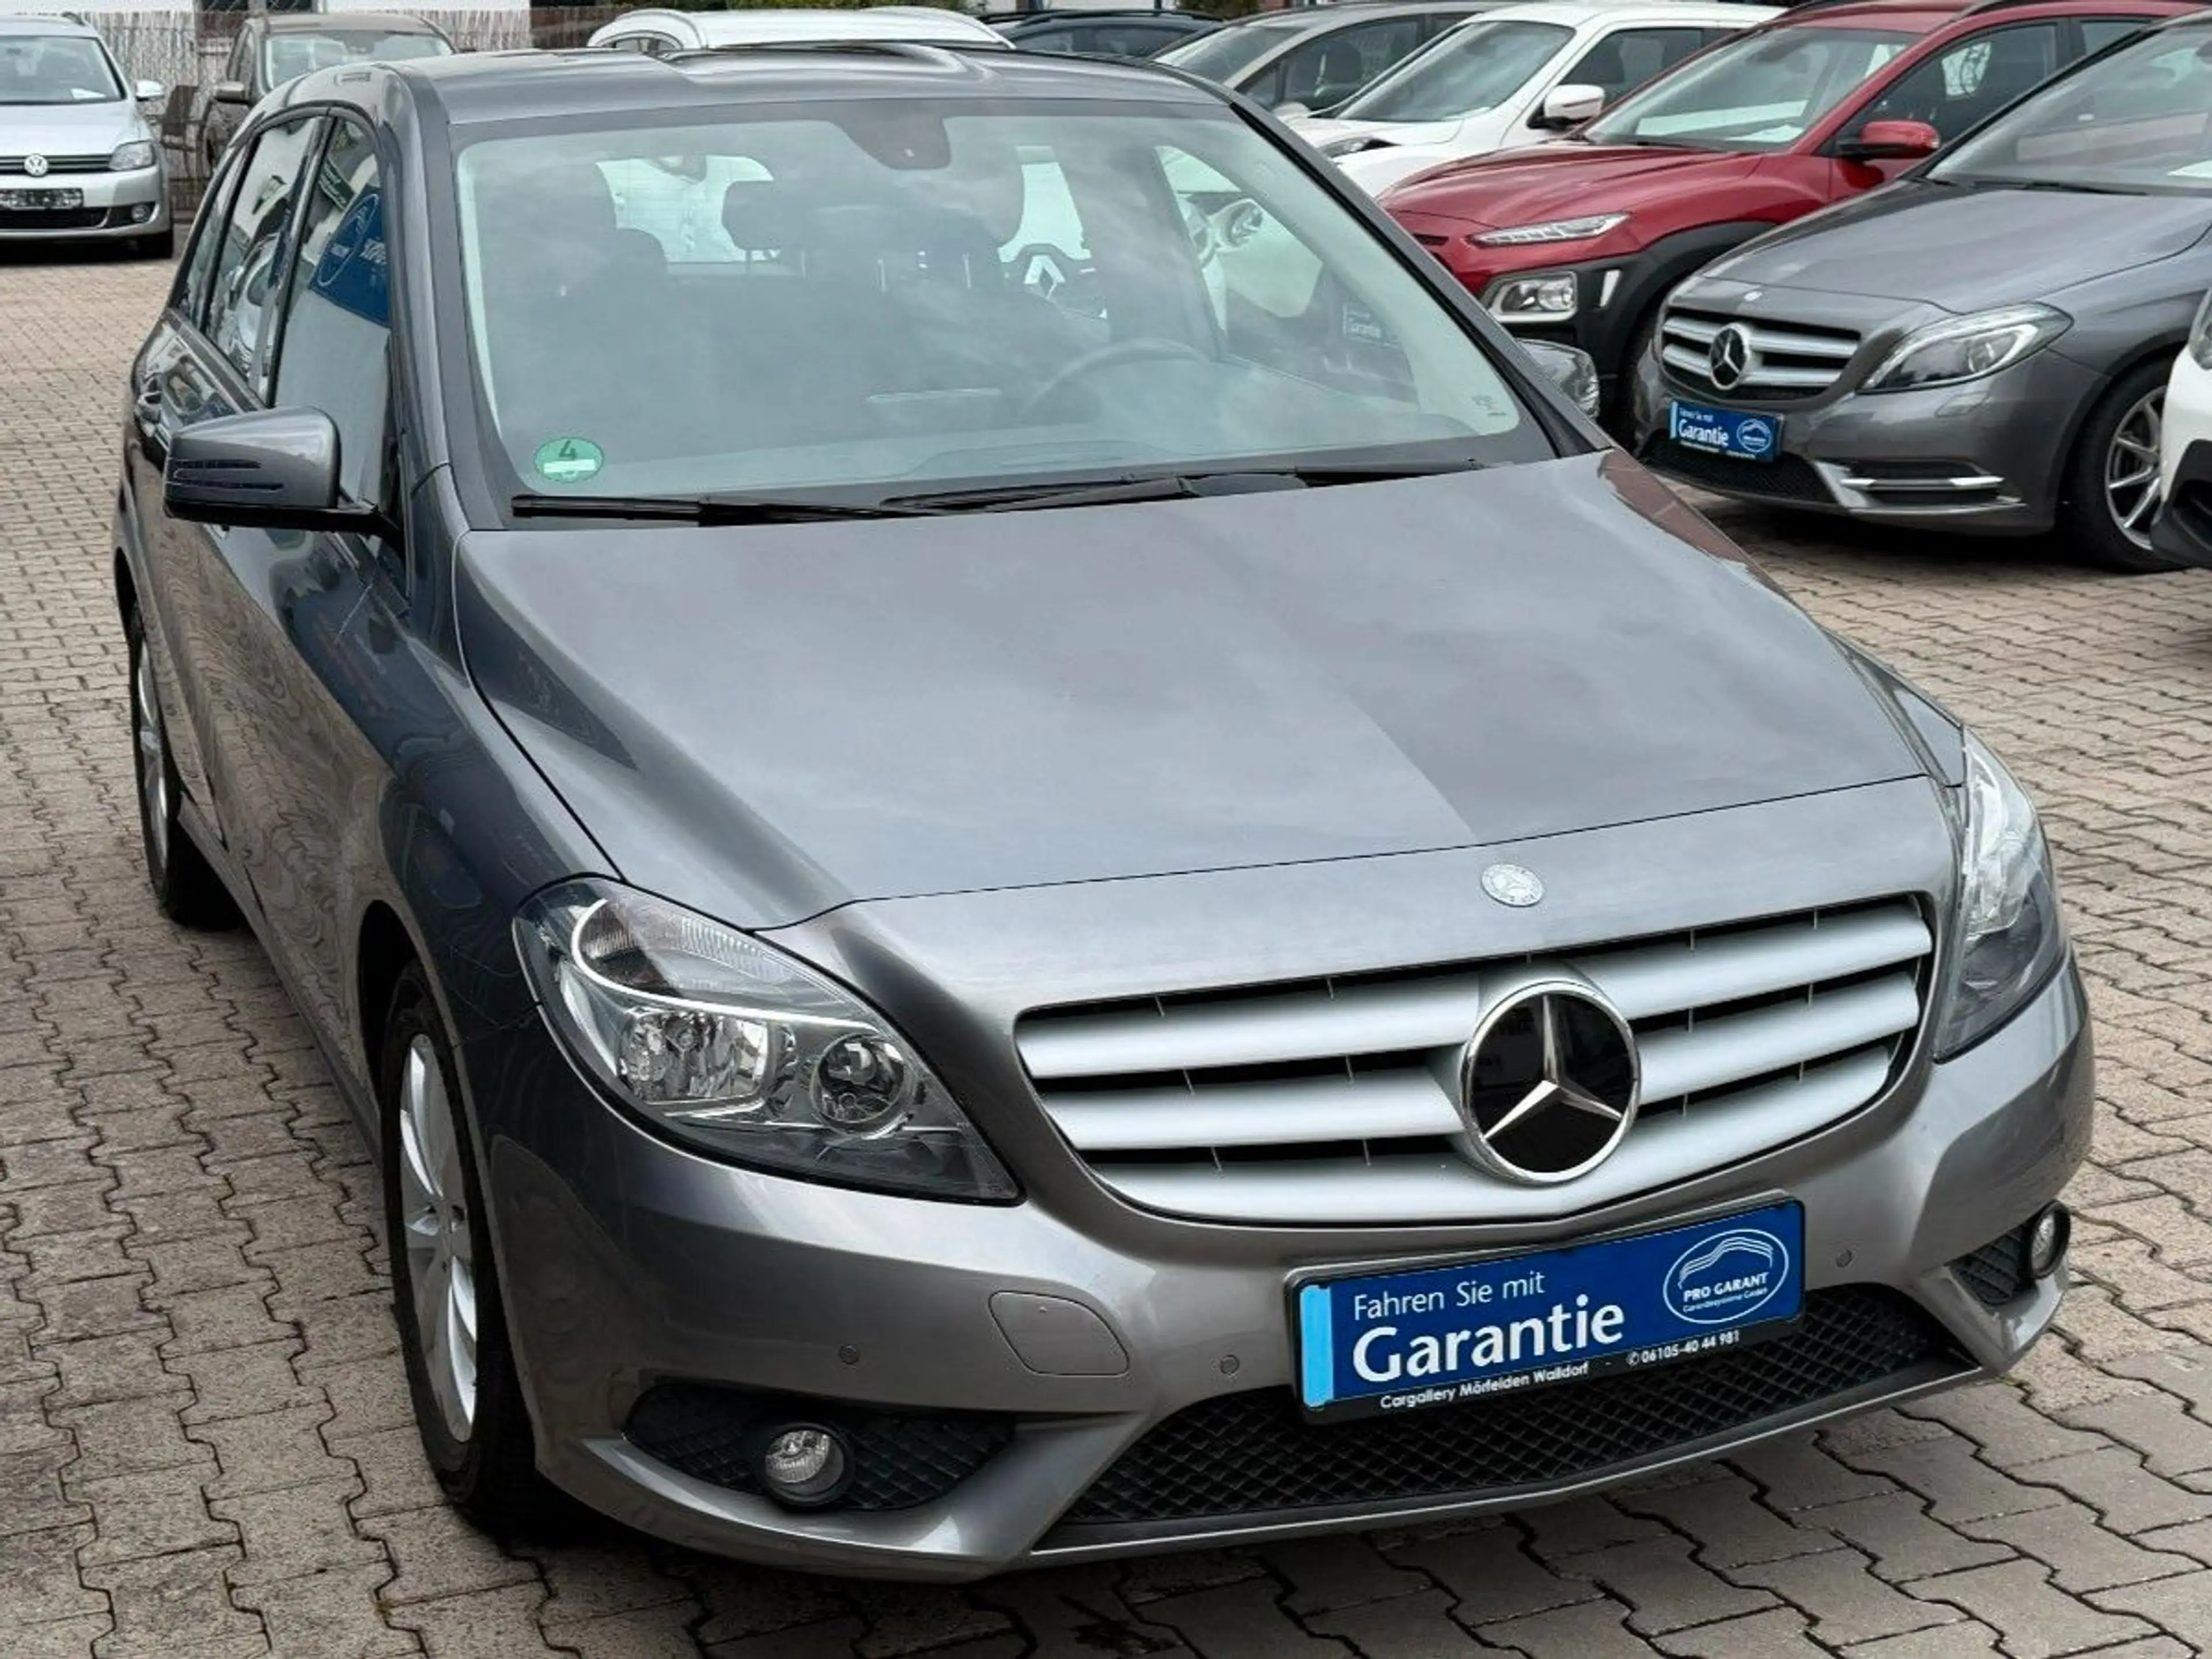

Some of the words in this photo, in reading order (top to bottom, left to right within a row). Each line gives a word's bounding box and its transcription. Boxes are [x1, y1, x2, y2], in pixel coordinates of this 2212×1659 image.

[559, 440, 578, 459] 4
[1679, 418, 1729, 448] Garantie
[1354, 1290, 1445, 1321] Fahren
[1456, 1280, 1493, 1306] Sie
[1502, 1270, 1546, 1299] mit
[1683, 1286, 1711, 1302] PRO
[1713, 1271, 1770, 1295] GARANT
[1352, 1293, 1624, 1382] Garantie
[1380, 1387, 1456, 1408] Cargallery
[1459, 1374, 1529, 1397] Mörfelden
[1533, 1361, 1589, 1383] Walldorf
[1701, 1335, 1717, 1350] 44
